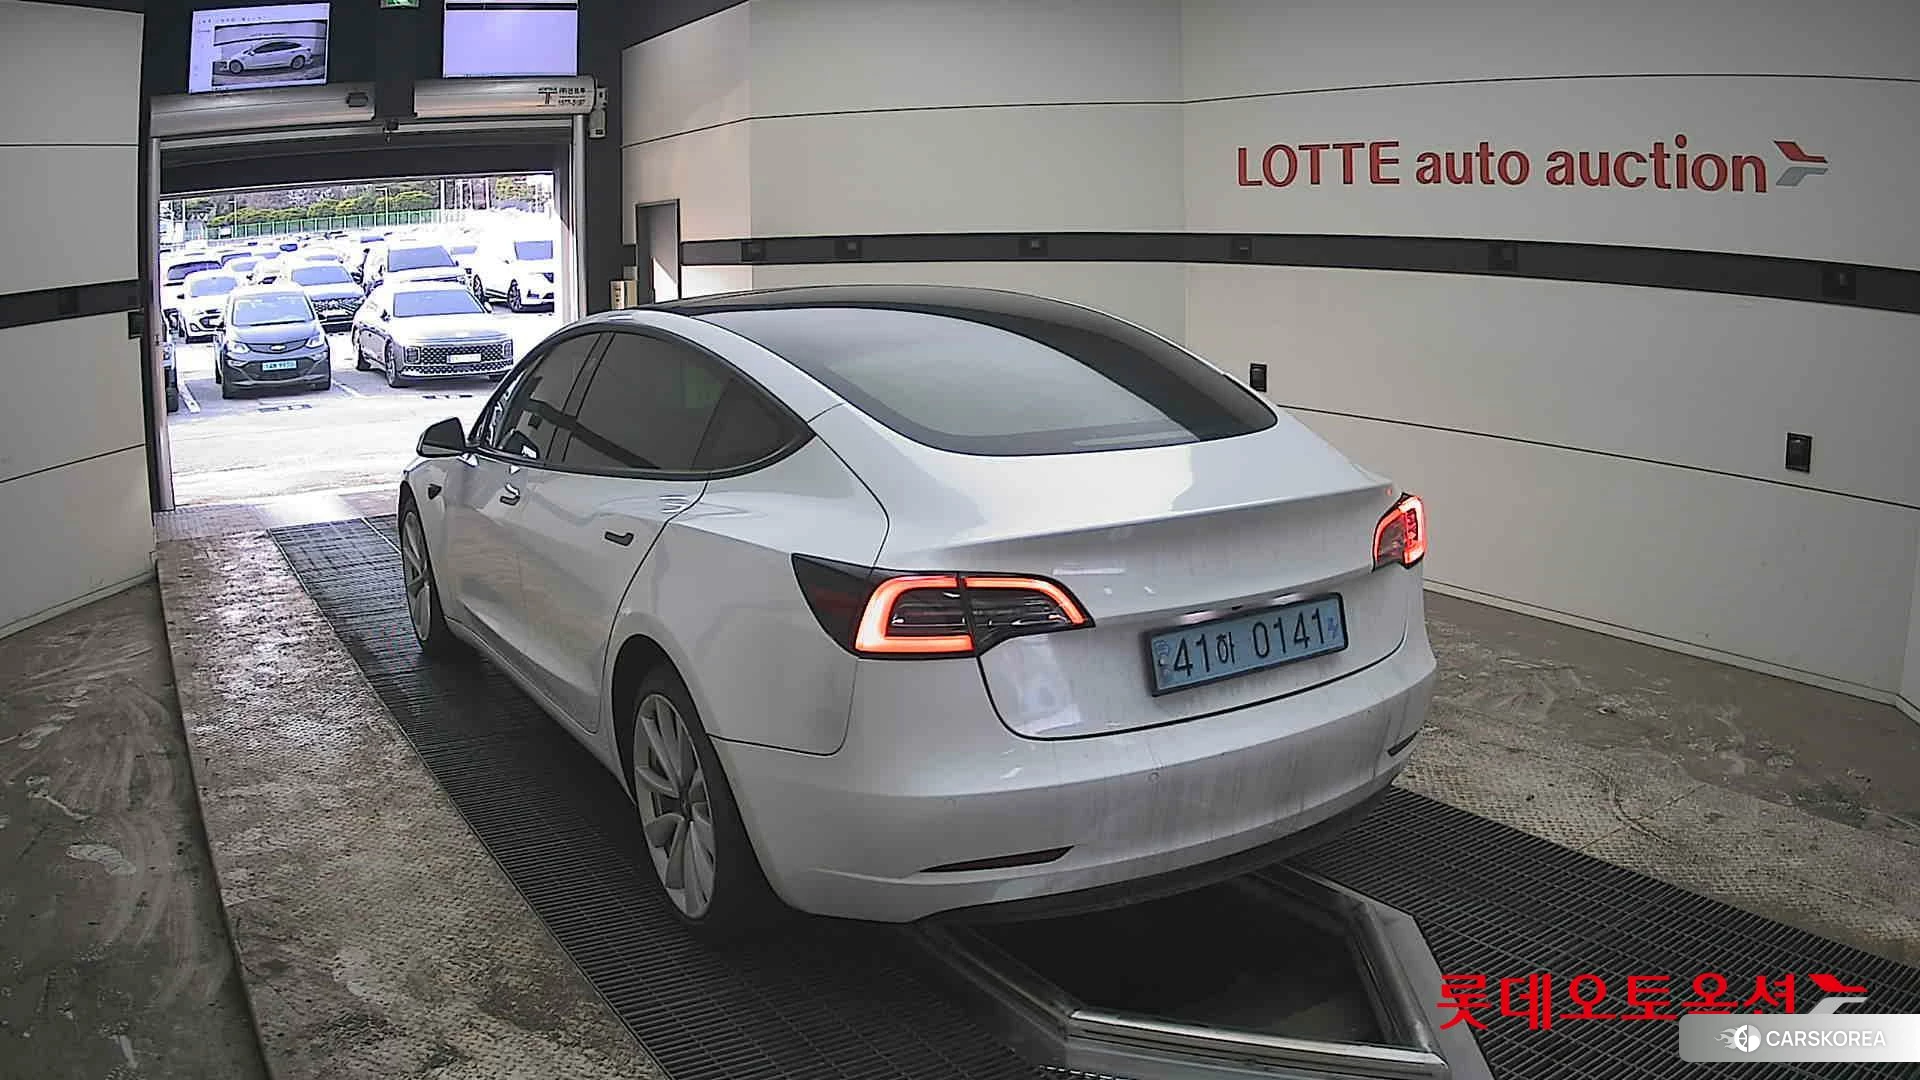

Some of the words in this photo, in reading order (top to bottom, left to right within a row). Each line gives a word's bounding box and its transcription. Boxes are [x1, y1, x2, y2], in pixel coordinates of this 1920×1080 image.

[1238, 141, 1400, 187] LOTTE
[1415, 142, 1530, 185] auto
[1546, 134, 1767, 193] auction
[1174, 631, 1236, 677] 41하
[1252, 607, 1325, 659] 0141
